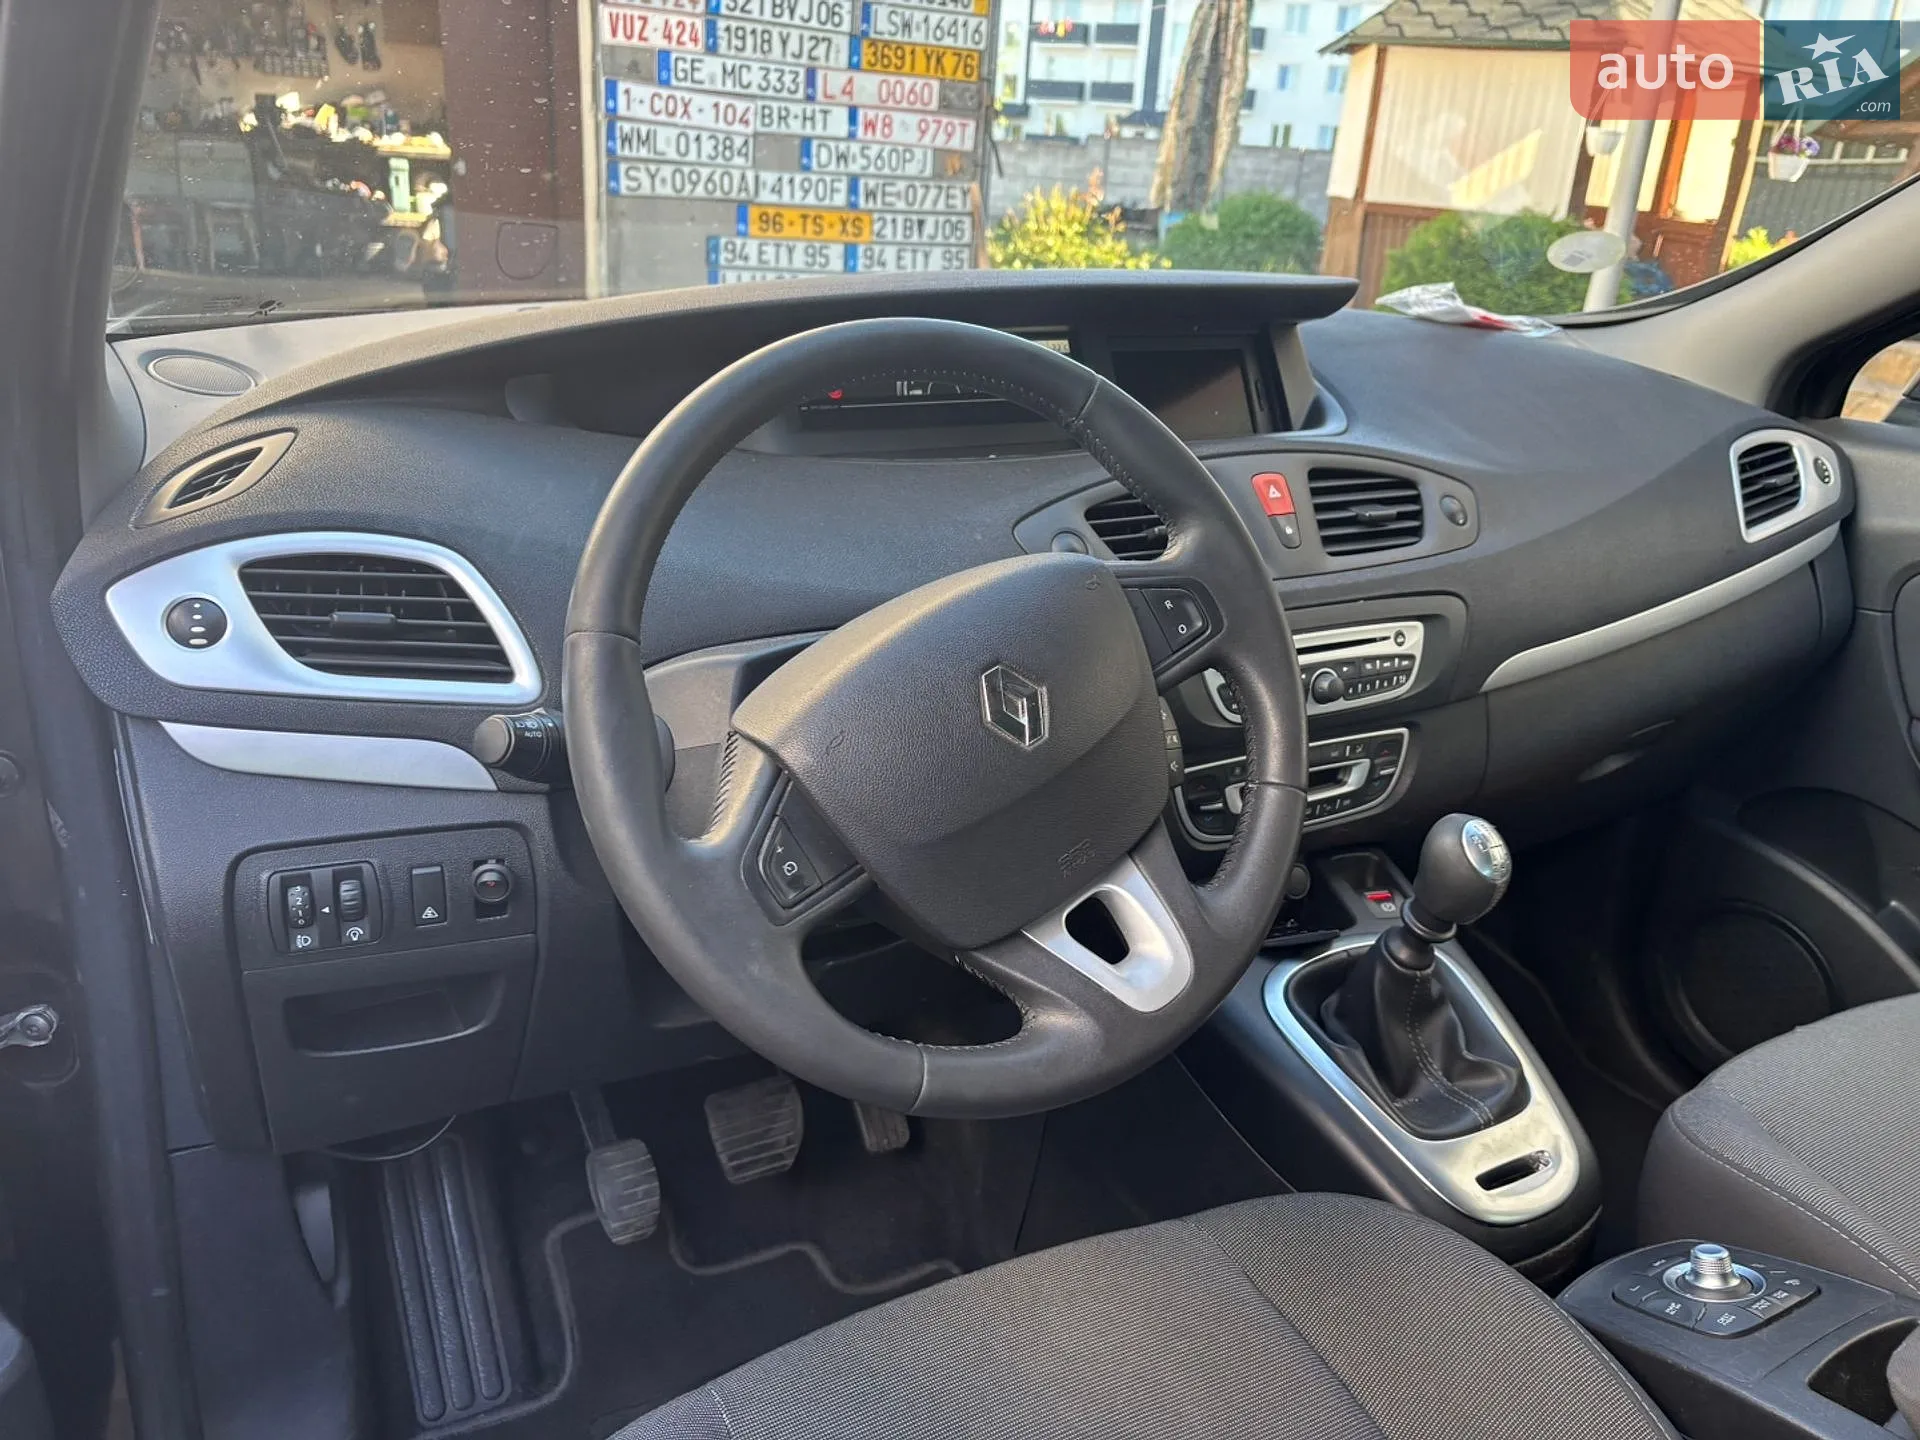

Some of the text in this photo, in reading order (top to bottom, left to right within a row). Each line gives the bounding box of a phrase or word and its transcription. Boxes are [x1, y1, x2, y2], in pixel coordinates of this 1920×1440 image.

[673, 55, 704, 84] GE
[822, 73, 934, 106] L4 0060
[861, 111, 970, 147] W8 979T
[618, 125, 750, 164] WML 01384
[723, 240, 831, 268] 94 ETY 95
[863, 245, 966, 270] 94 ETY 95
[1164, 600, 1174, 609] R
